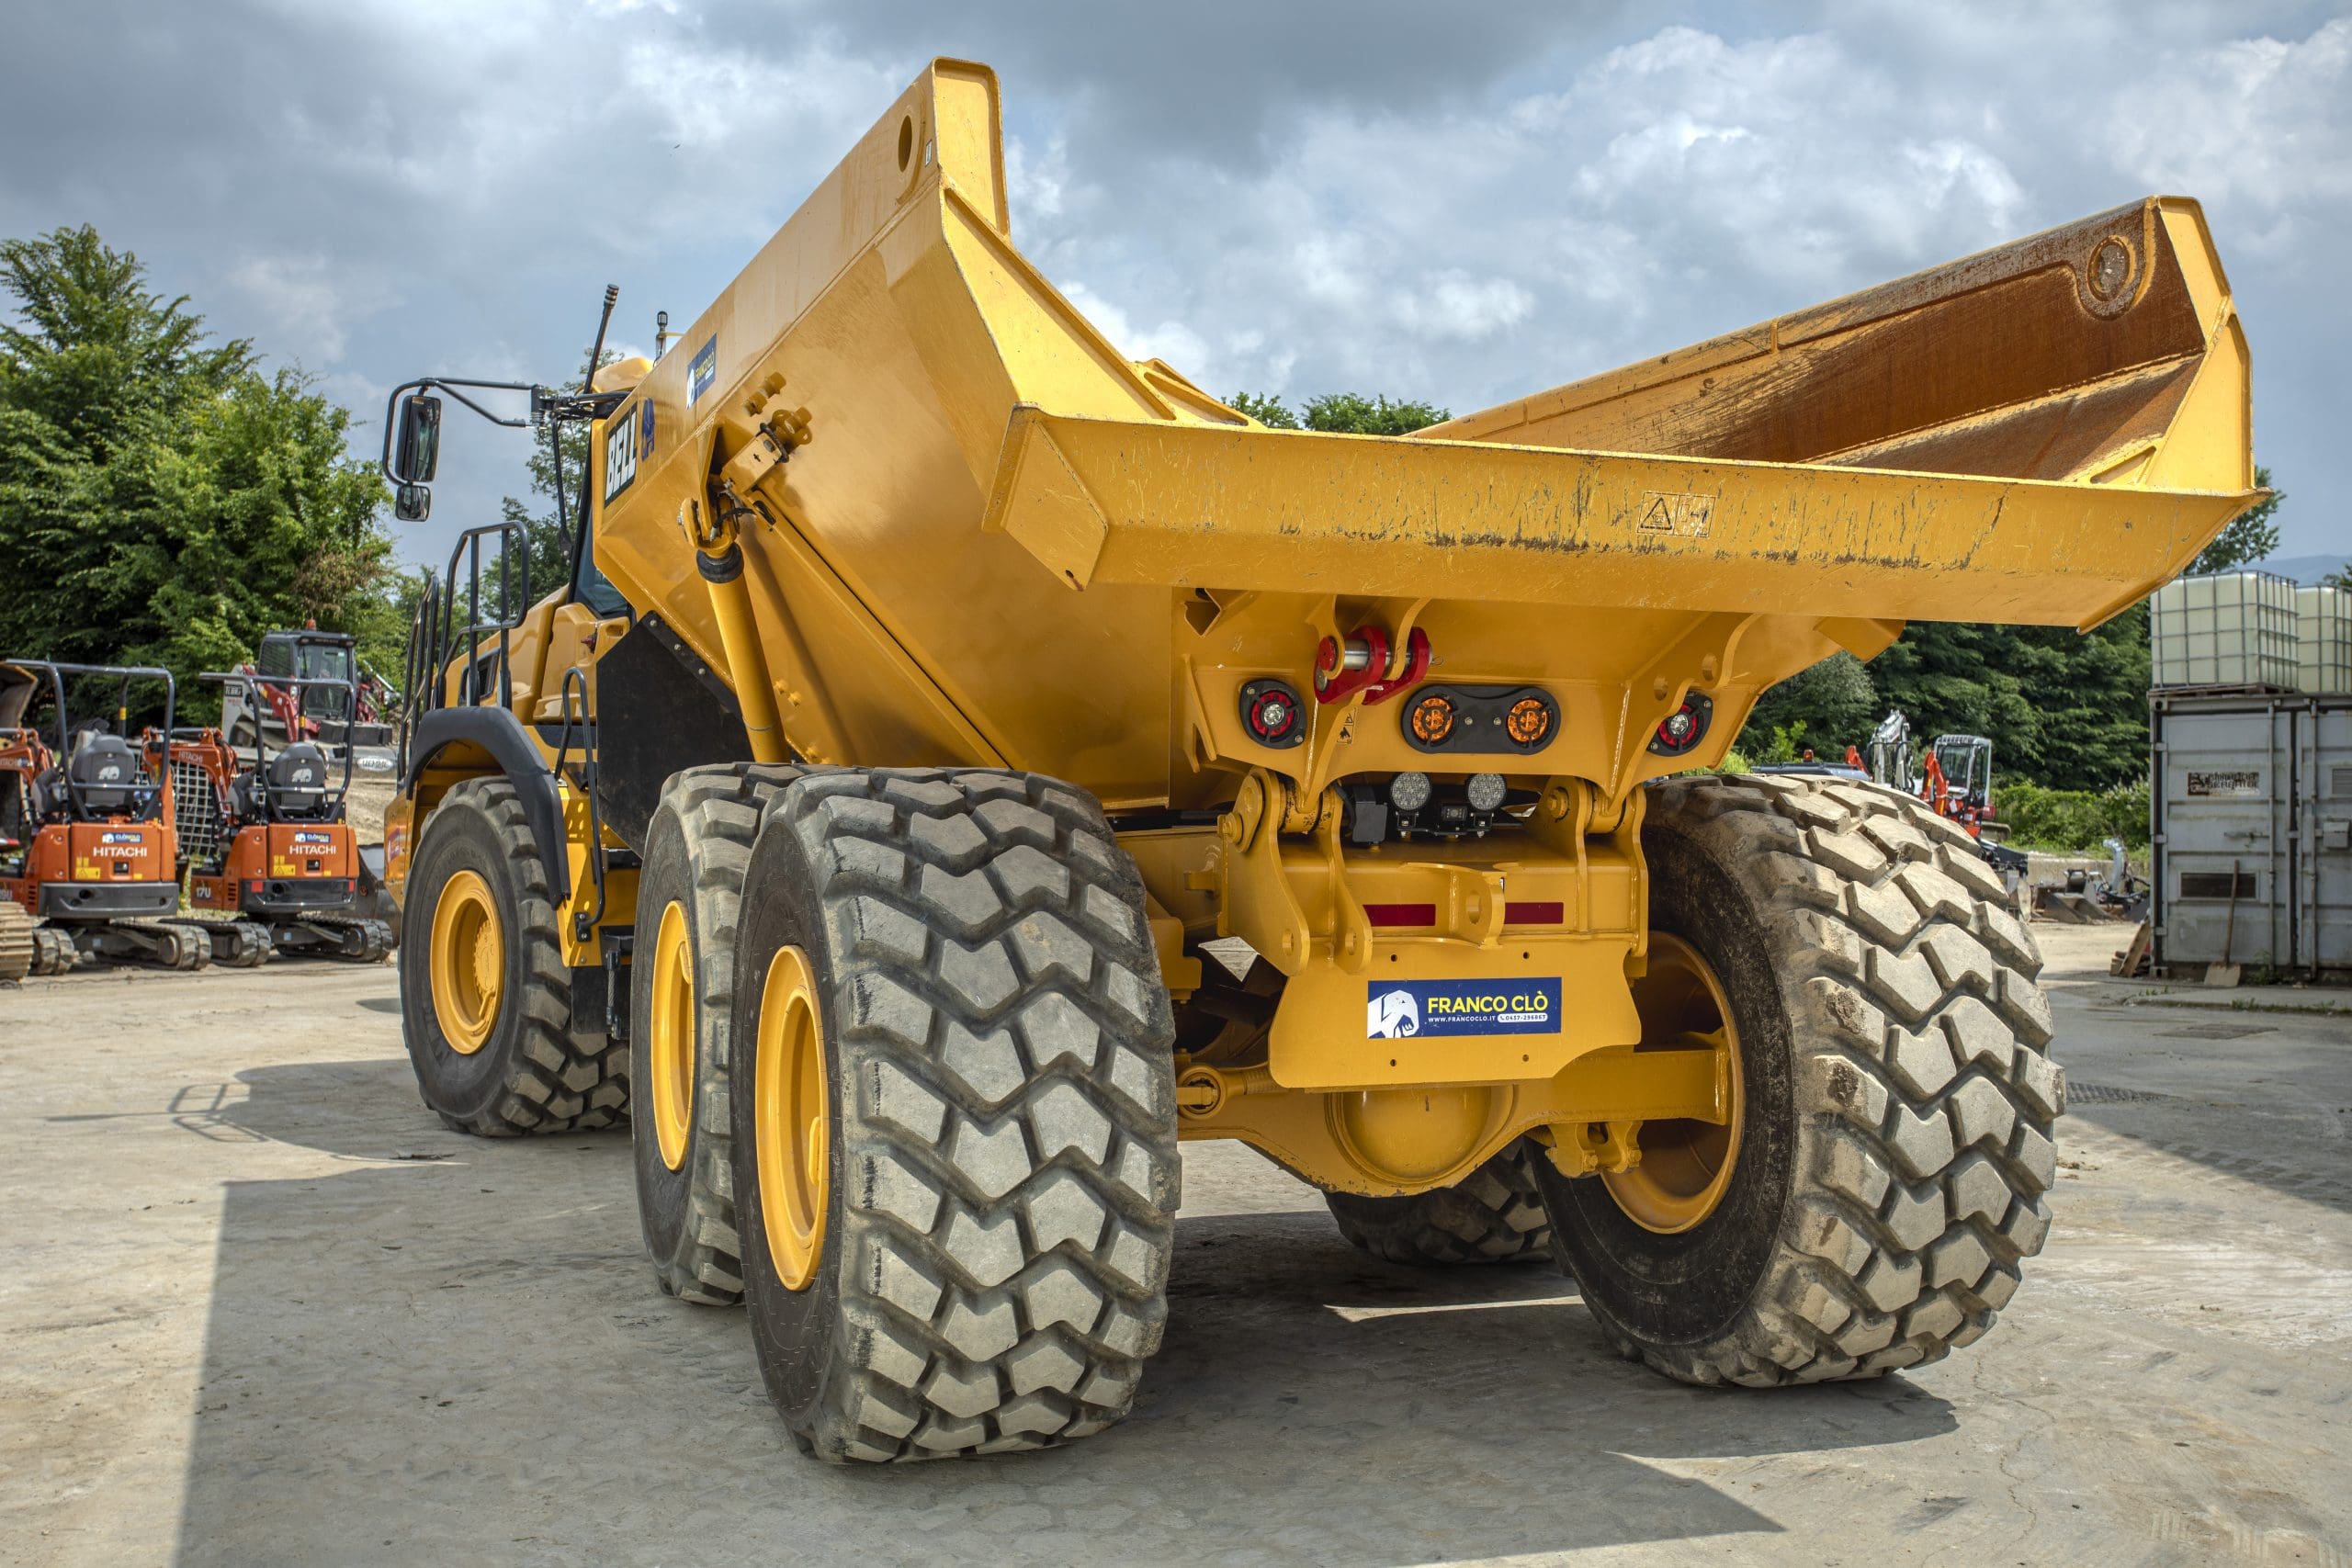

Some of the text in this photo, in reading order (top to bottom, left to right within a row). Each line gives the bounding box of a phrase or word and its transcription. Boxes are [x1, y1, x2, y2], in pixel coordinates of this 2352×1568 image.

[605, 412, 637, 501] BELL
[93, 846, 147, 857] HITACHI
[289, 845, 336, 855] HITACHI
[196, 886, 211, 898] 17U
[1428, 990, 1548, 1013] FRANCO CLÒ
